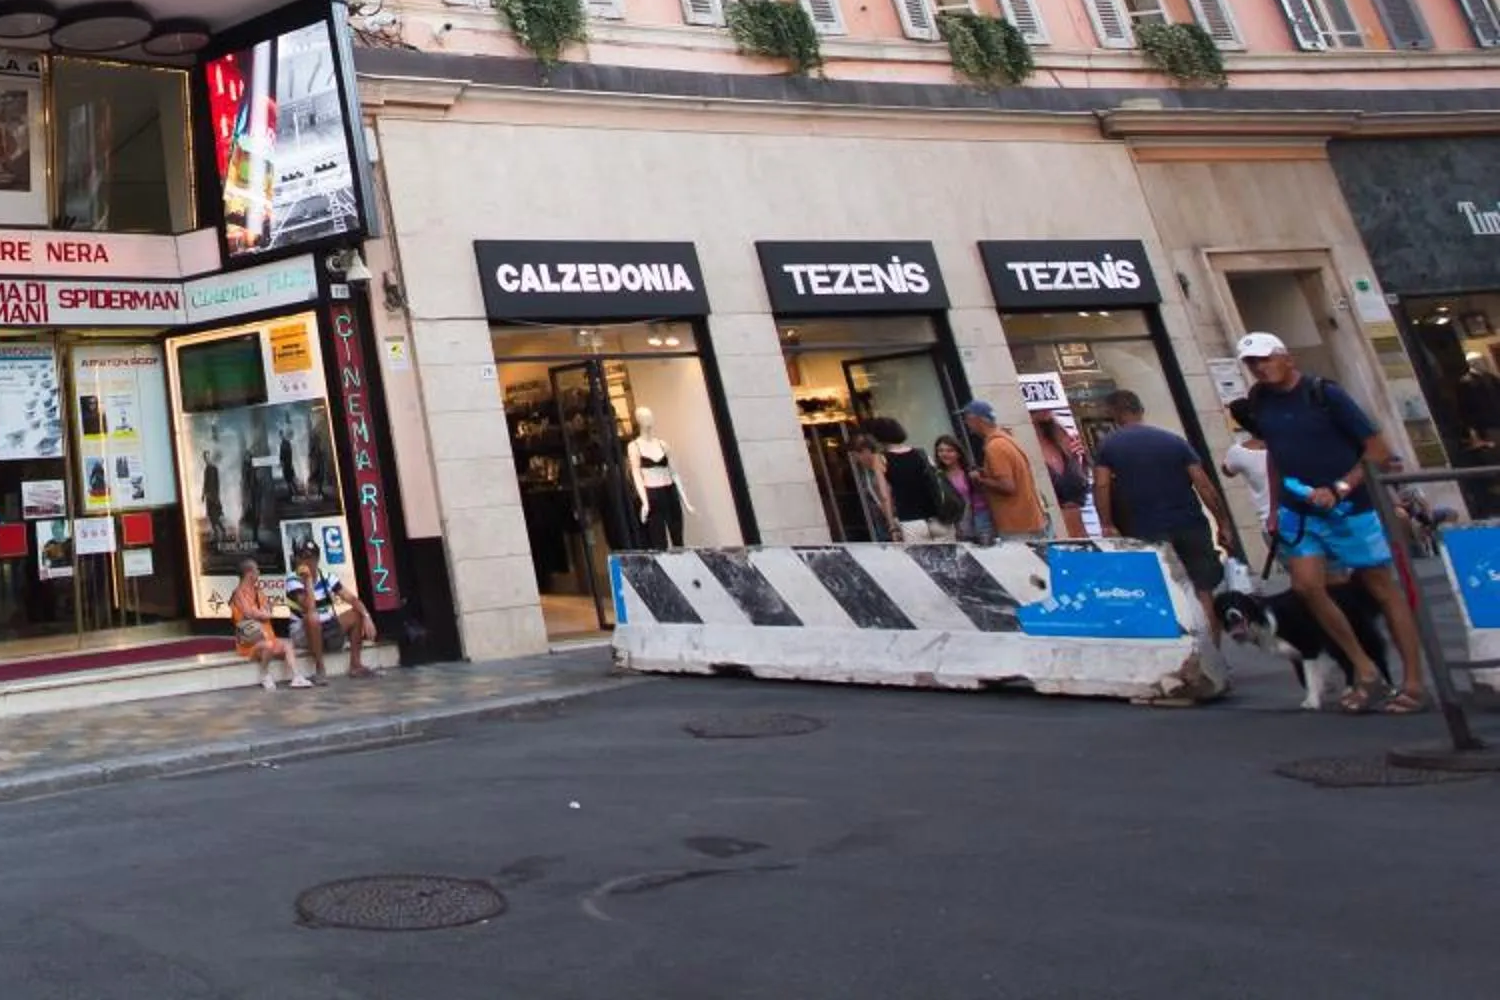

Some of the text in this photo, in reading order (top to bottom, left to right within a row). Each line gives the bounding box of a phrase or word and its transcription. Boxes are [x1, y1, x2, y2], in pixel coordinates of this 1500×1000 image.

[26, 59, 40, 73] 4
[1457, 201, 1500, 235] Tim
[46, 240, 109, 263] NERA
[497, 262, 693, 293] CALZEDONIA
[783, 255, 930, 295] TEZENIS
[1006, 252, 1141, 291] TEZENIS
[25, 282, 47, 304] DI
[59, 288, 180, 311] SPIDERMAN
[334, 314, 391, 593] CINEMA RITZ
